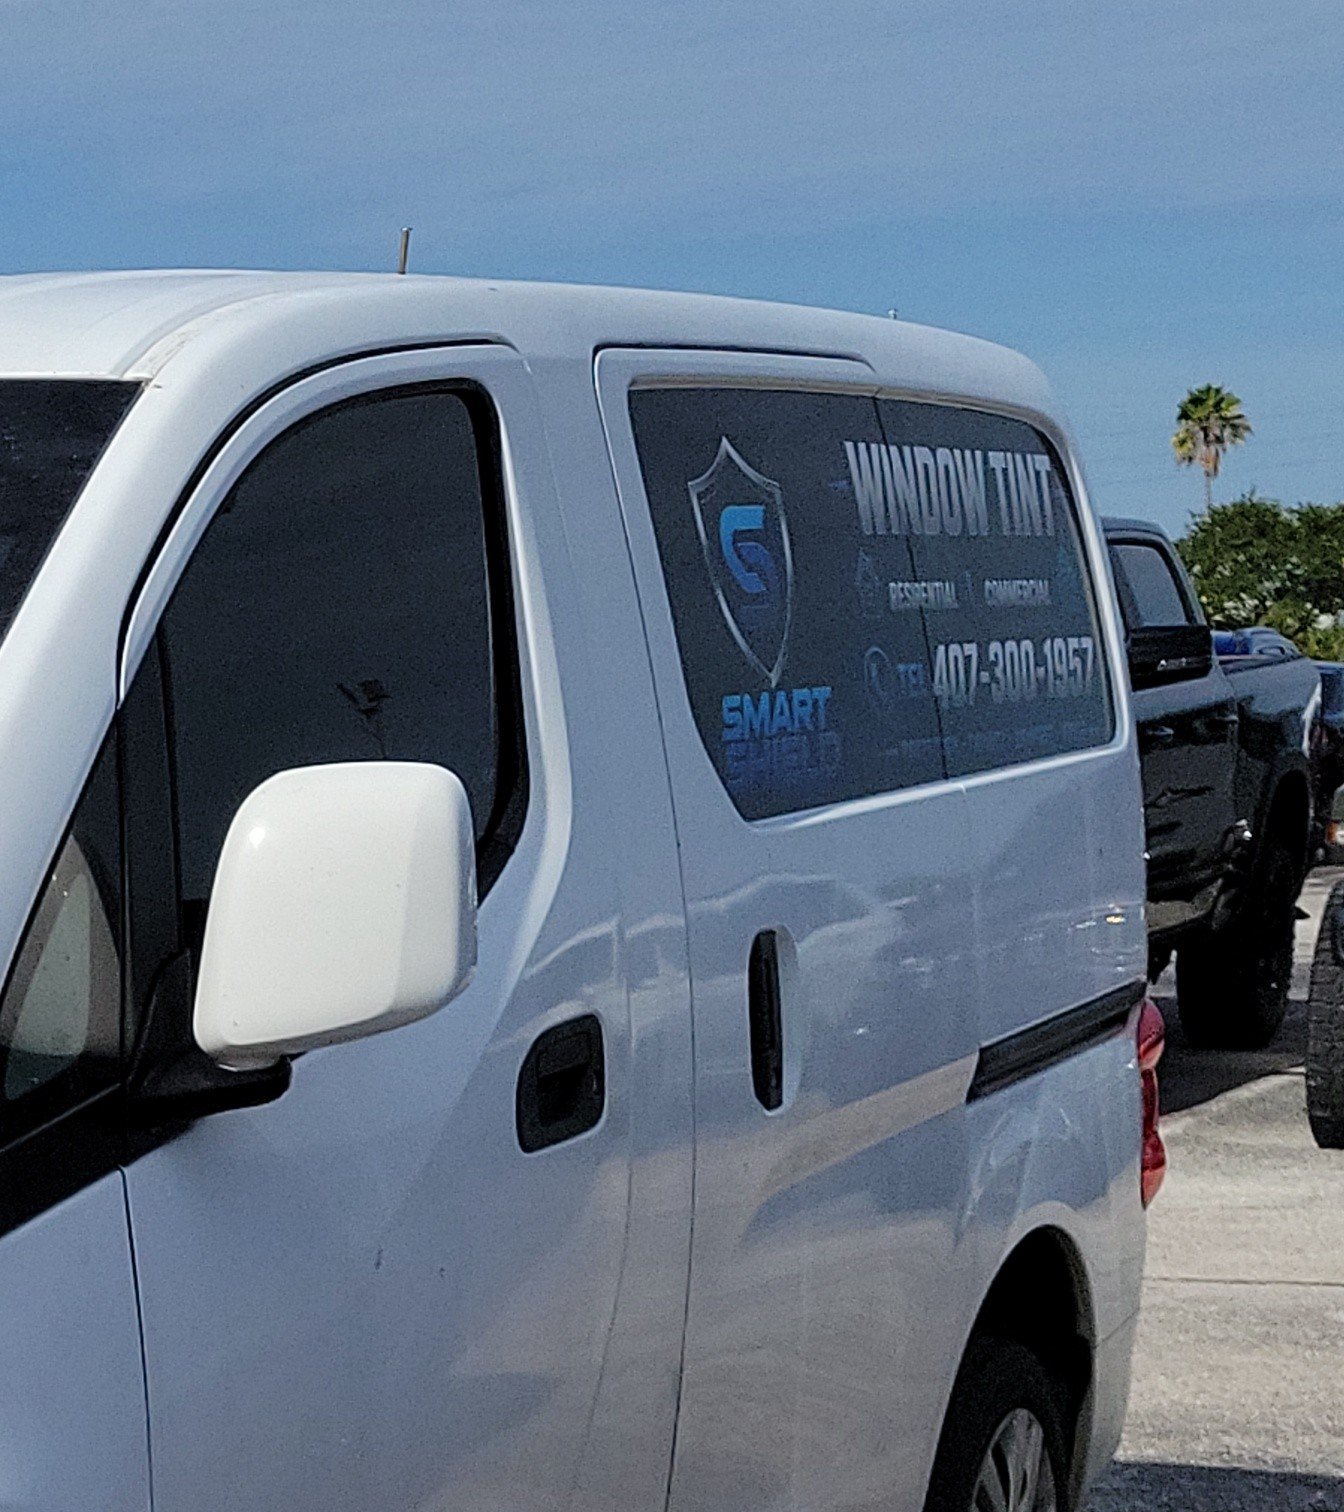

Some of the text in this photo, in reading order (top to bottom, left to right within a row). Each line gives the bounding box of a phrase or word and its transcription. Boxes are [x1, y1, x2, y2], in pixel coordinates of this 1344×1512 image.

[843, 440, 1055, 537] WINDOW TINT
[933, 636, 1094, 705] 407-300-1957
[722, 686, 832, 741] SMART
